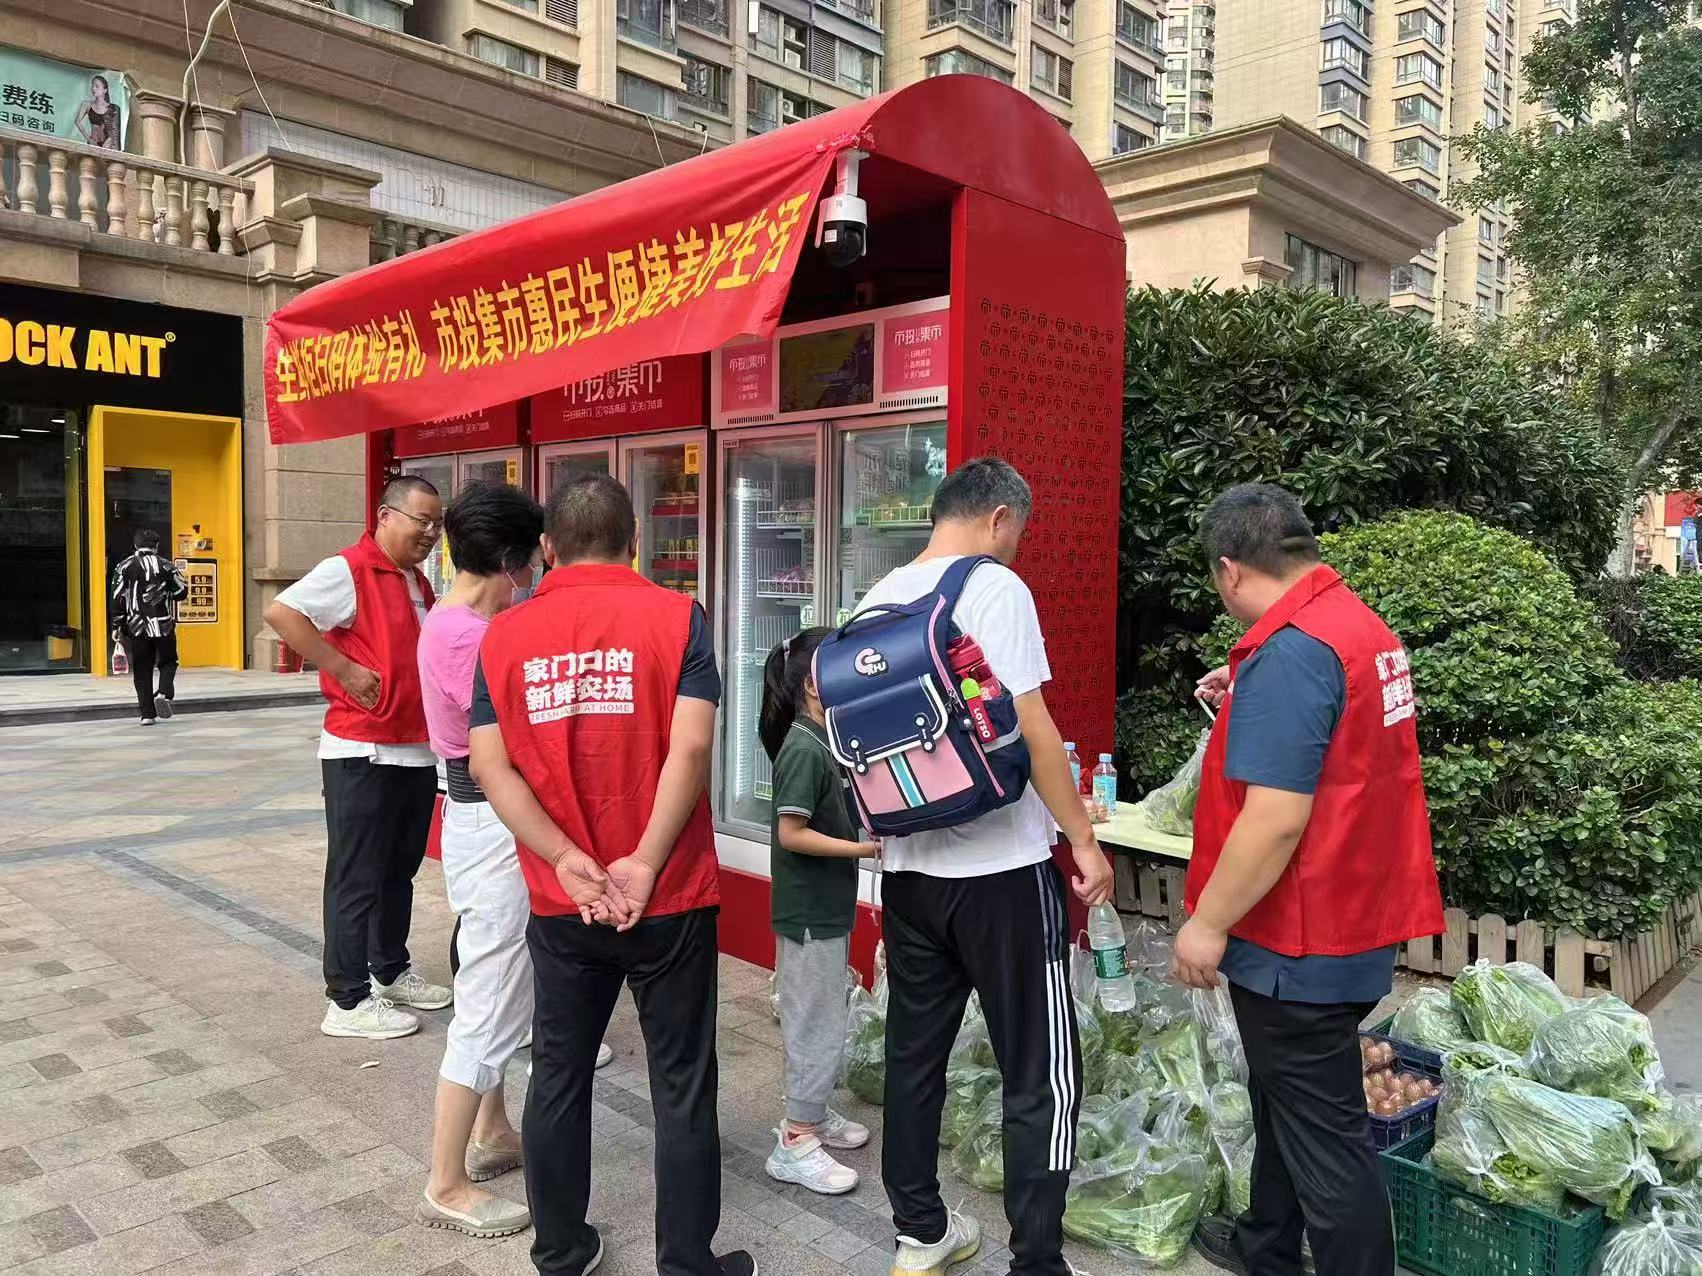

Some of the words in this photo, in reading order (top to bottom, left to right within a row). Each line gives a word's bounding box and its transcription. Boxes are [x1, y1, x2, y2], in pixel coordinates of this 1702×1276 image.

[2, 84, 55, 115] 费练
[430, 191, 810, 373] 市投集市惠民生便捷美好生活
[85, 329, 166, 378] ANT
[523, 648, 634, 683] 家门口的
[525, 675, 633, 711] 新鲜农场
[583, 704, 596, 712] AT
[599, 703, 631, 712] HOME
[973, 707, 991, 739] LOTSO
